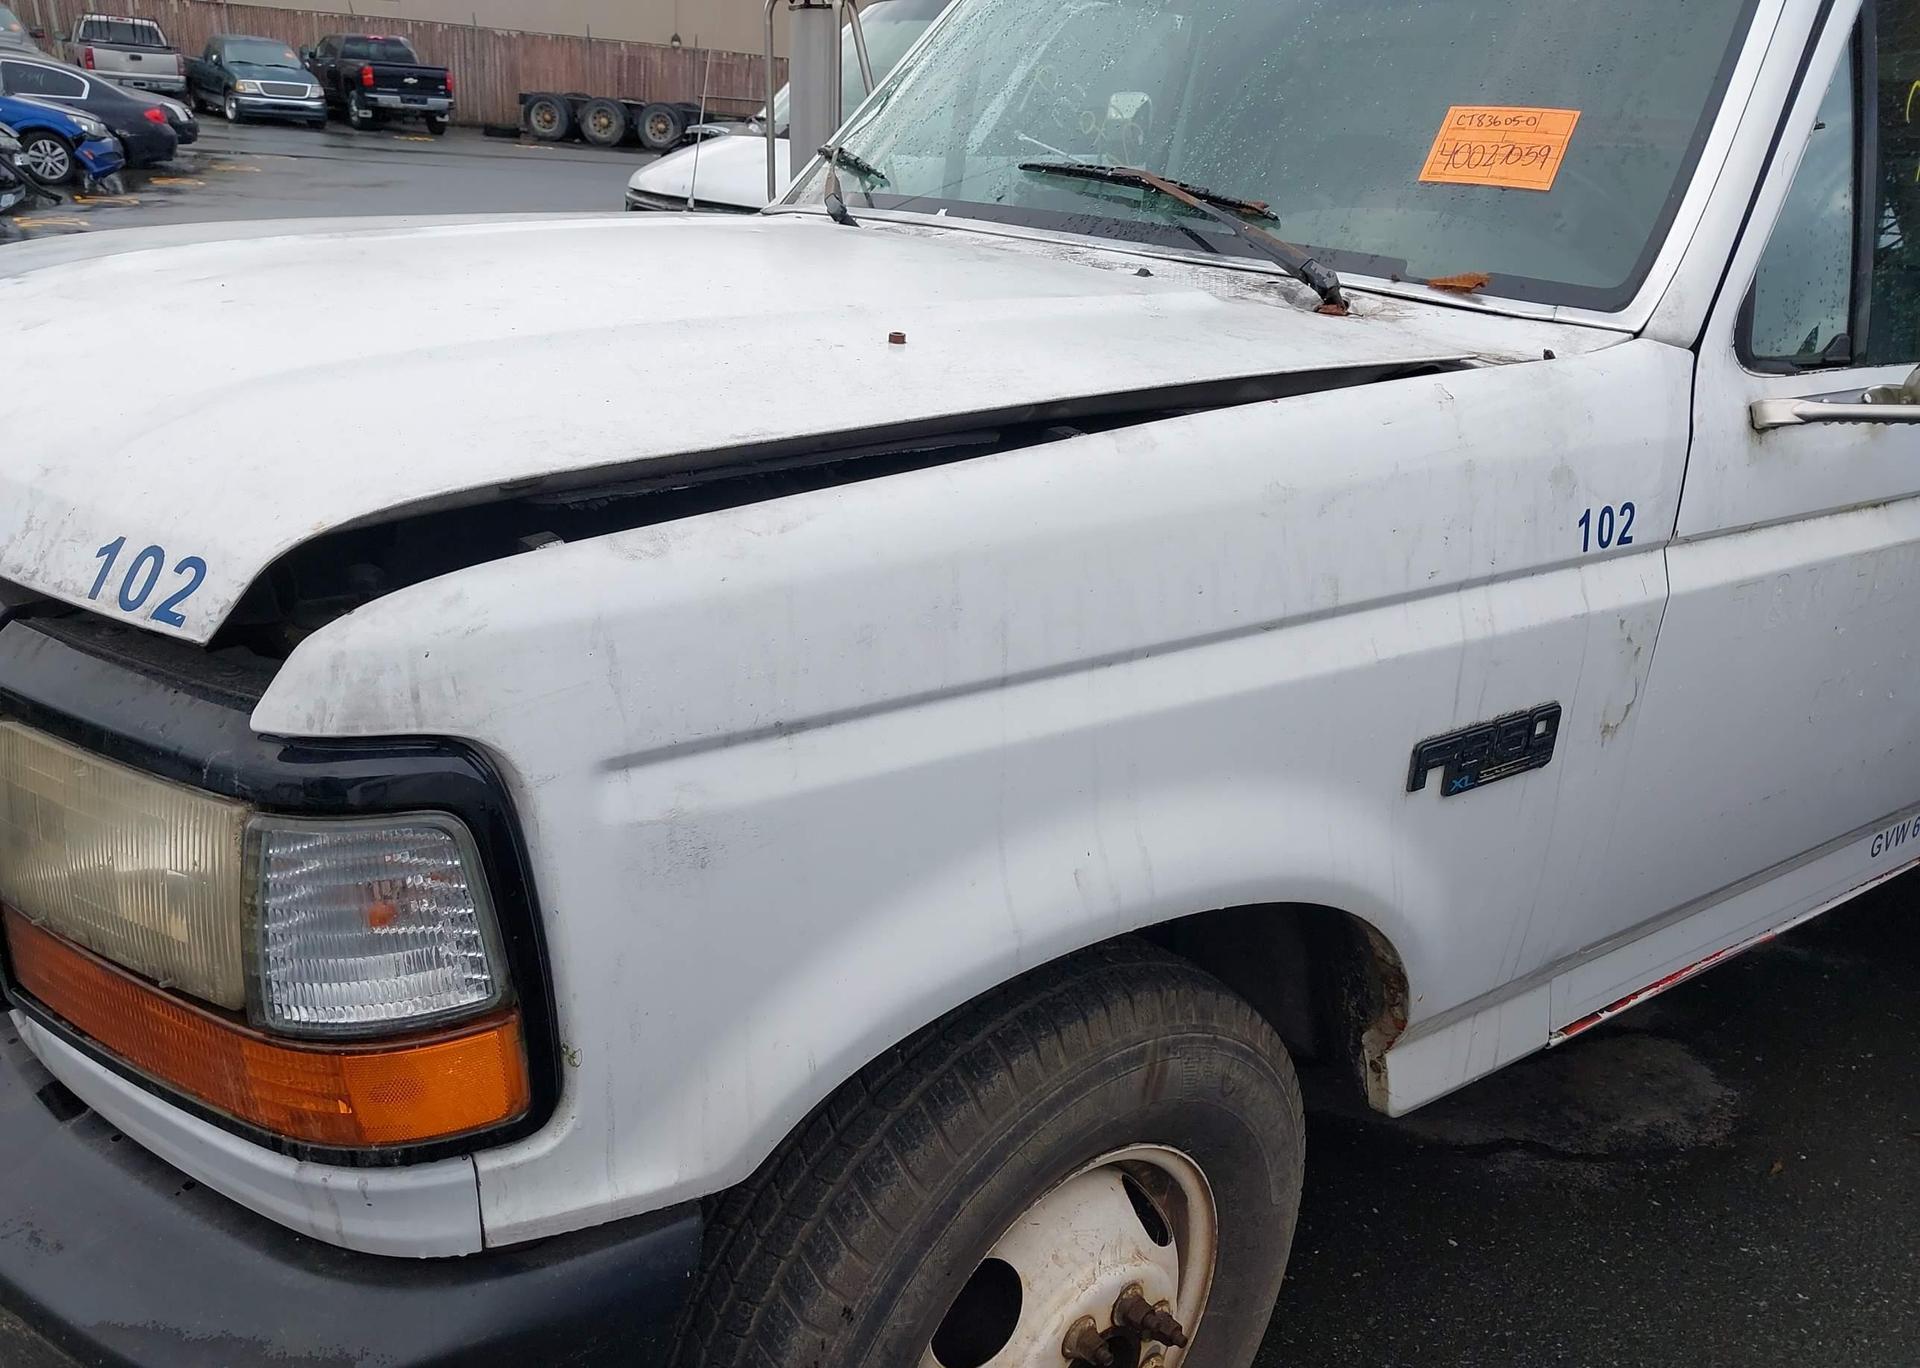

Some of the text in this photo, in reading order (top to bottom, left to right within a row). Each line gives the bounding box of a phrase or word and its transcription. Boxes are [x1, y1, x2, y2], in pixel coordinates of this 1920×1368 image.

[1440, 142, 1552, 172] 40027059
[1578, 501, 1636, 553] 102
[87, 536, 207, 628] 102
[1451, 775, 1475, 791] XL
[1870, 820, 1912, 858] GVW
